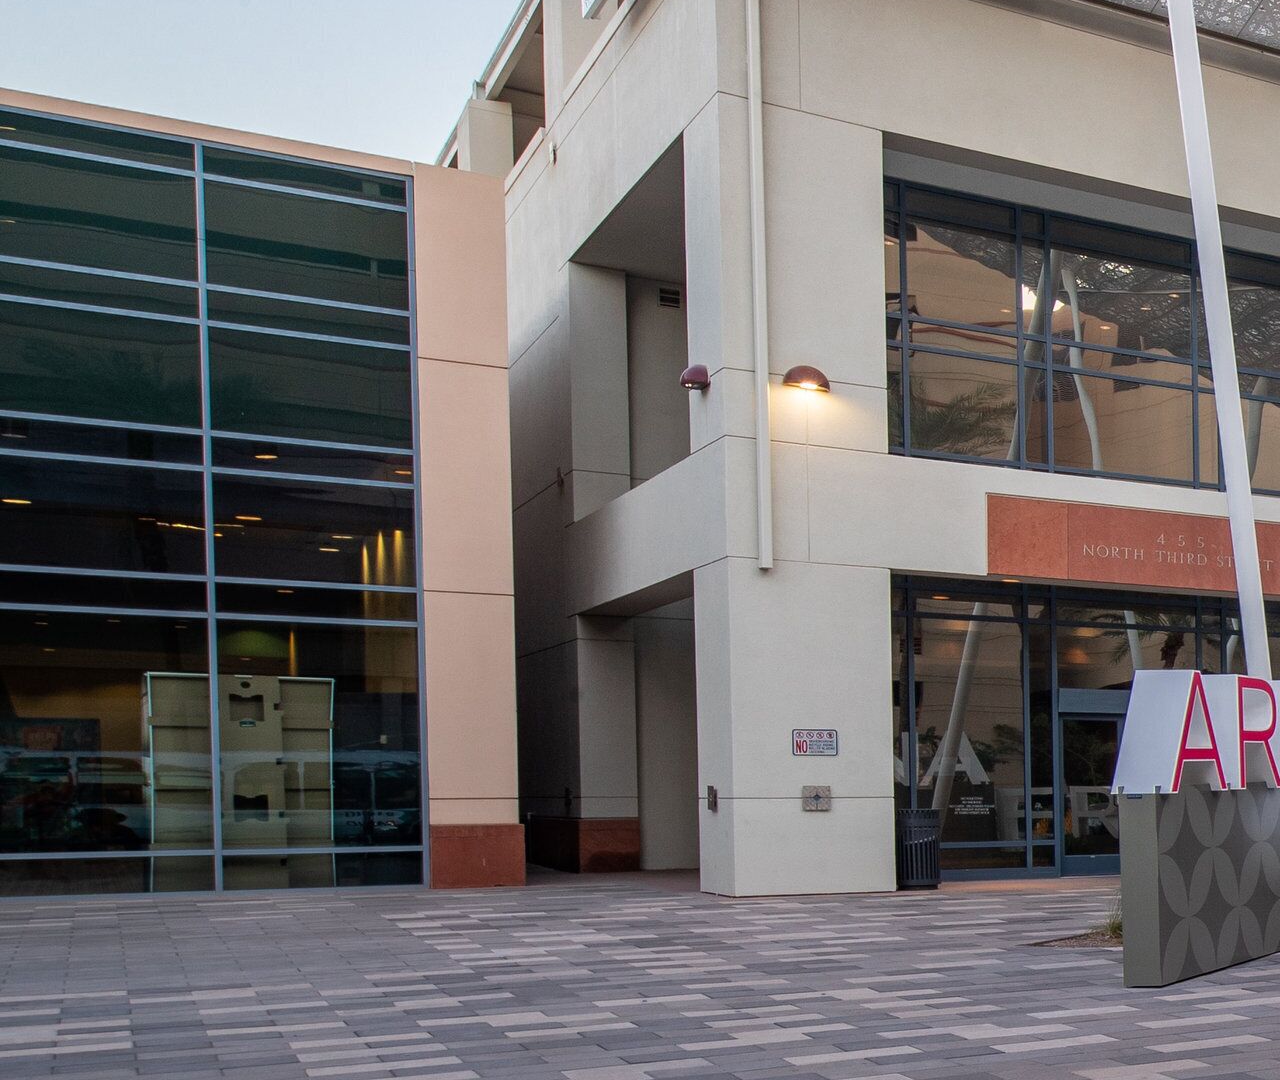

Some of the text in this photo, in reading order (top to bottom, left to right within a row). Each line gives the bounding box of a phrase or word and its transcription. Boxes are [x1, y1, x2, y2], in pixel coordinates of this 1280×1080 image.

[1082, 544, 1275, 573] NORTH THIRD STT
[795, 739, 808, 754] NO
